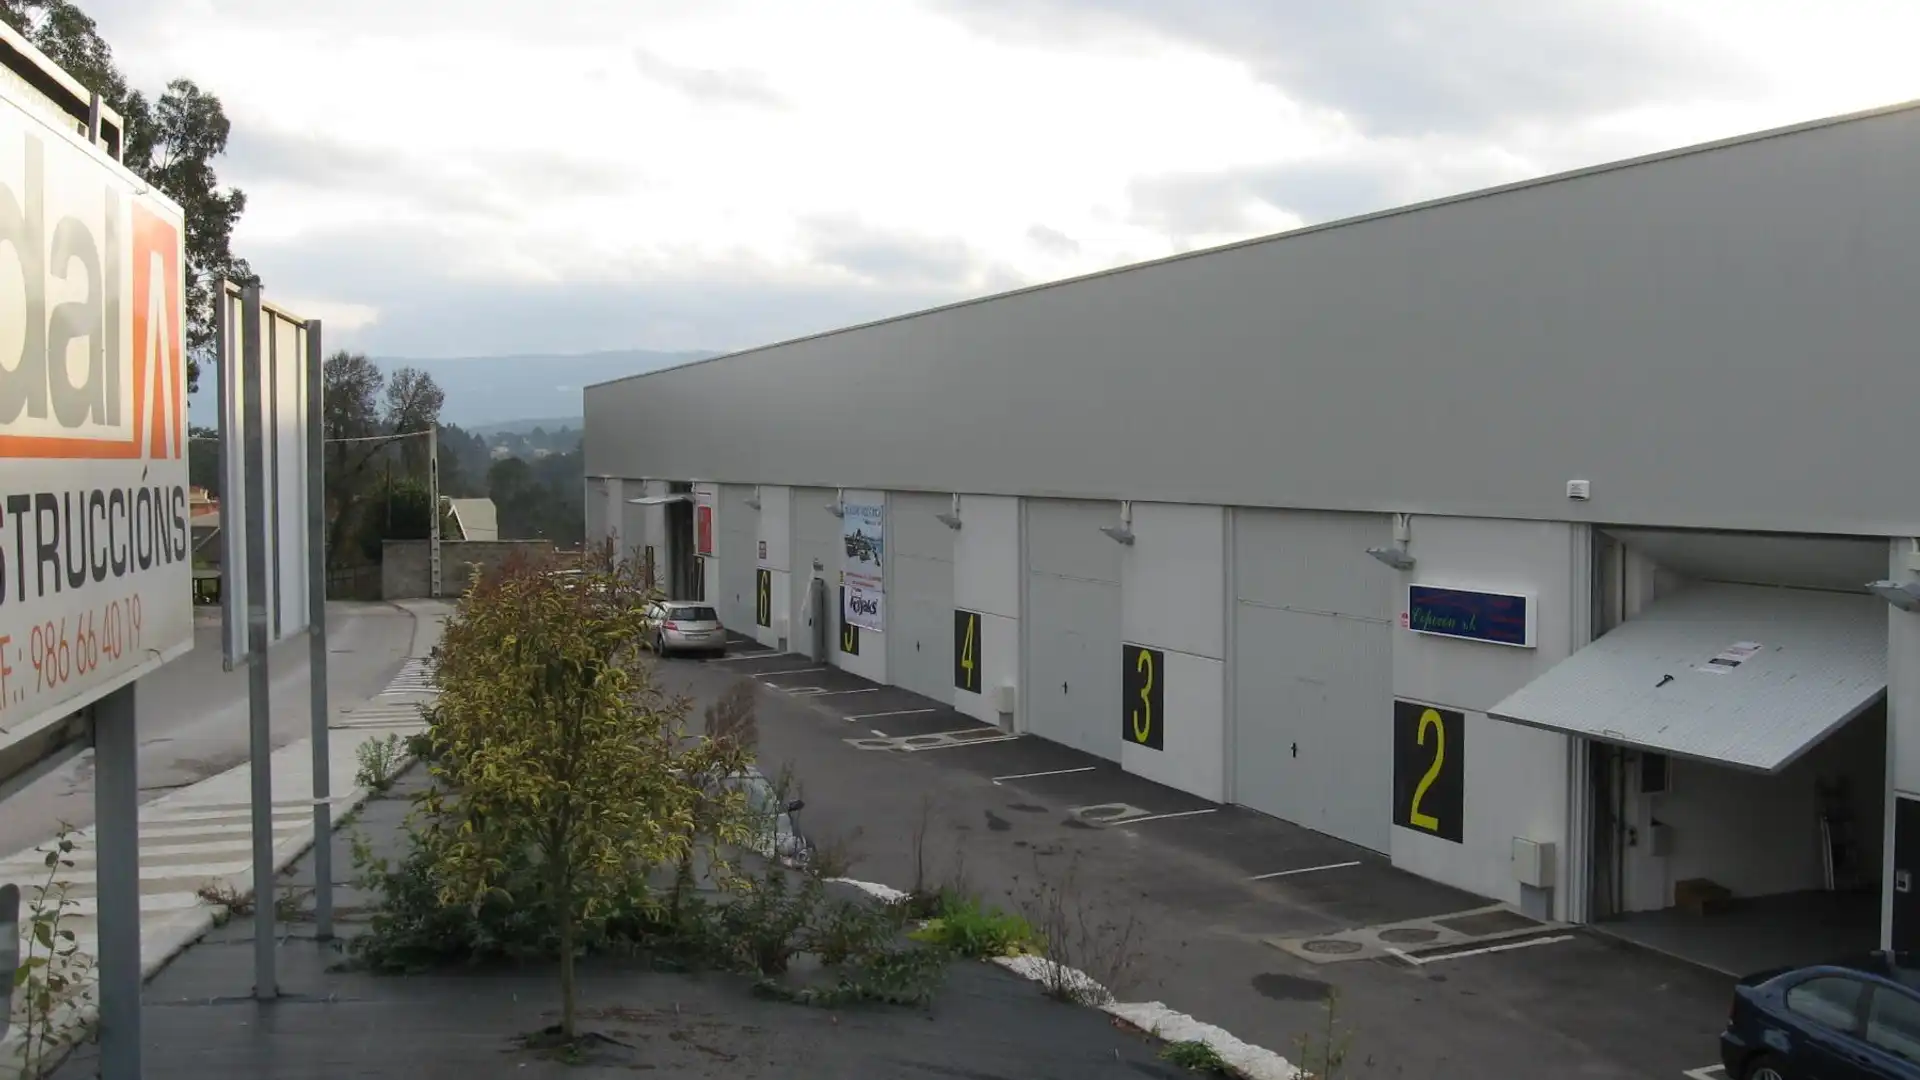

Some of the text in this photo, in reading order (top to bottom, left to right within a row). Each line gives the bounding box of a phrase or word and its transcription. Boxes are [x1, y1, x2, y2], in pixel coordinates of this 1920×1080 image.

[0, 465, 187, 606] TRUCCIÓNS
[31, 616, 70, 693] 986
[76, 610, 97, 675] 66
[102, 601, 122, 663] 40
[125, 593, 142, 652] 19
[760, 570, 768, 626] 6
[961, 613, 974, 688] 4
[1133, 649, 1154, 743] 3
[1410, 708, 1445, 831] 2
